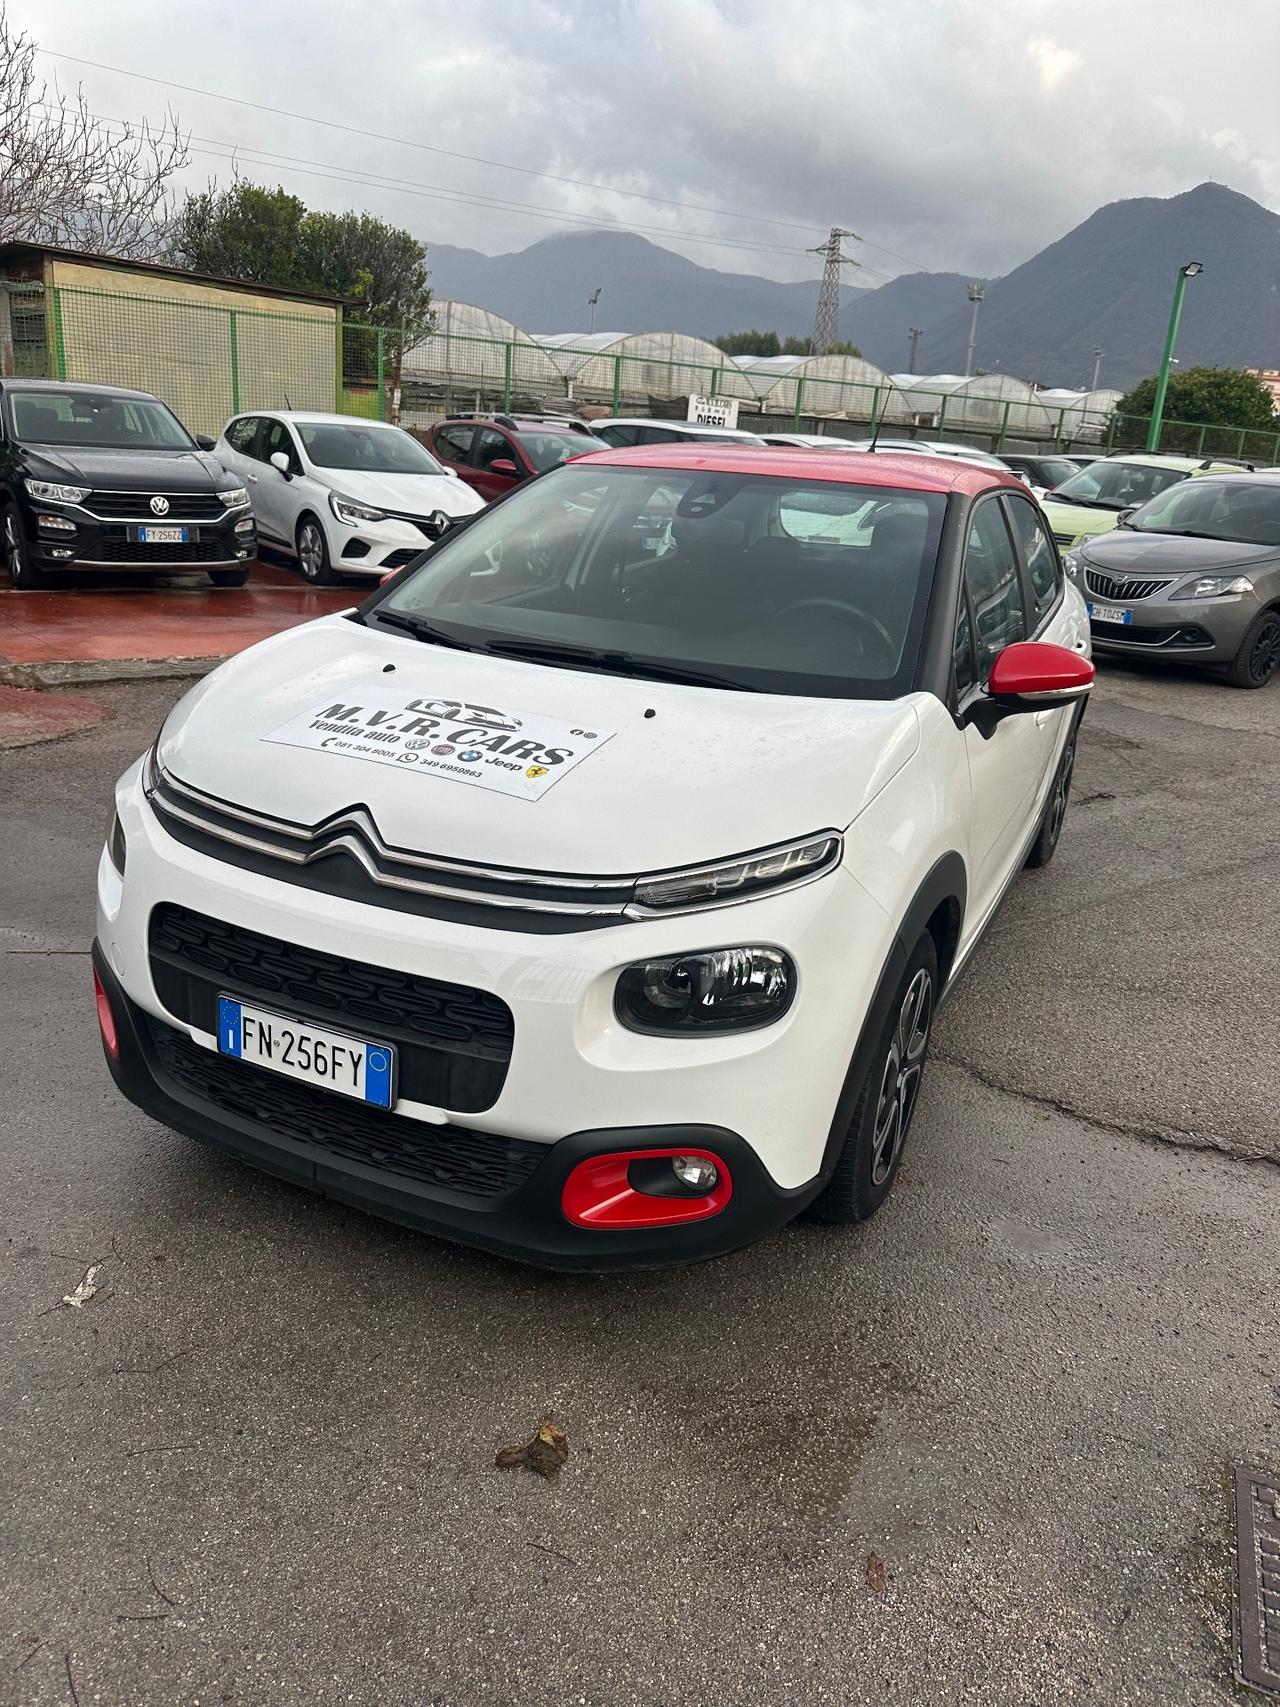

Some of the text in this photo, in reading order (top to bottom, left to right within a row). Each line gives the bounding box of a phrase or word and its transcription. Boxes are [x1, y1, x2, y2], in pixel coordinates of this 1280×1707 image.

[697, 414, 726, 427] DIESEL
[309, 720, 401, 744] Vendita auto
[352, 744, 372, 753] 304
[419, 758, 483, 778] 349 6959863
[485, 757, 523, 771] Jeep
